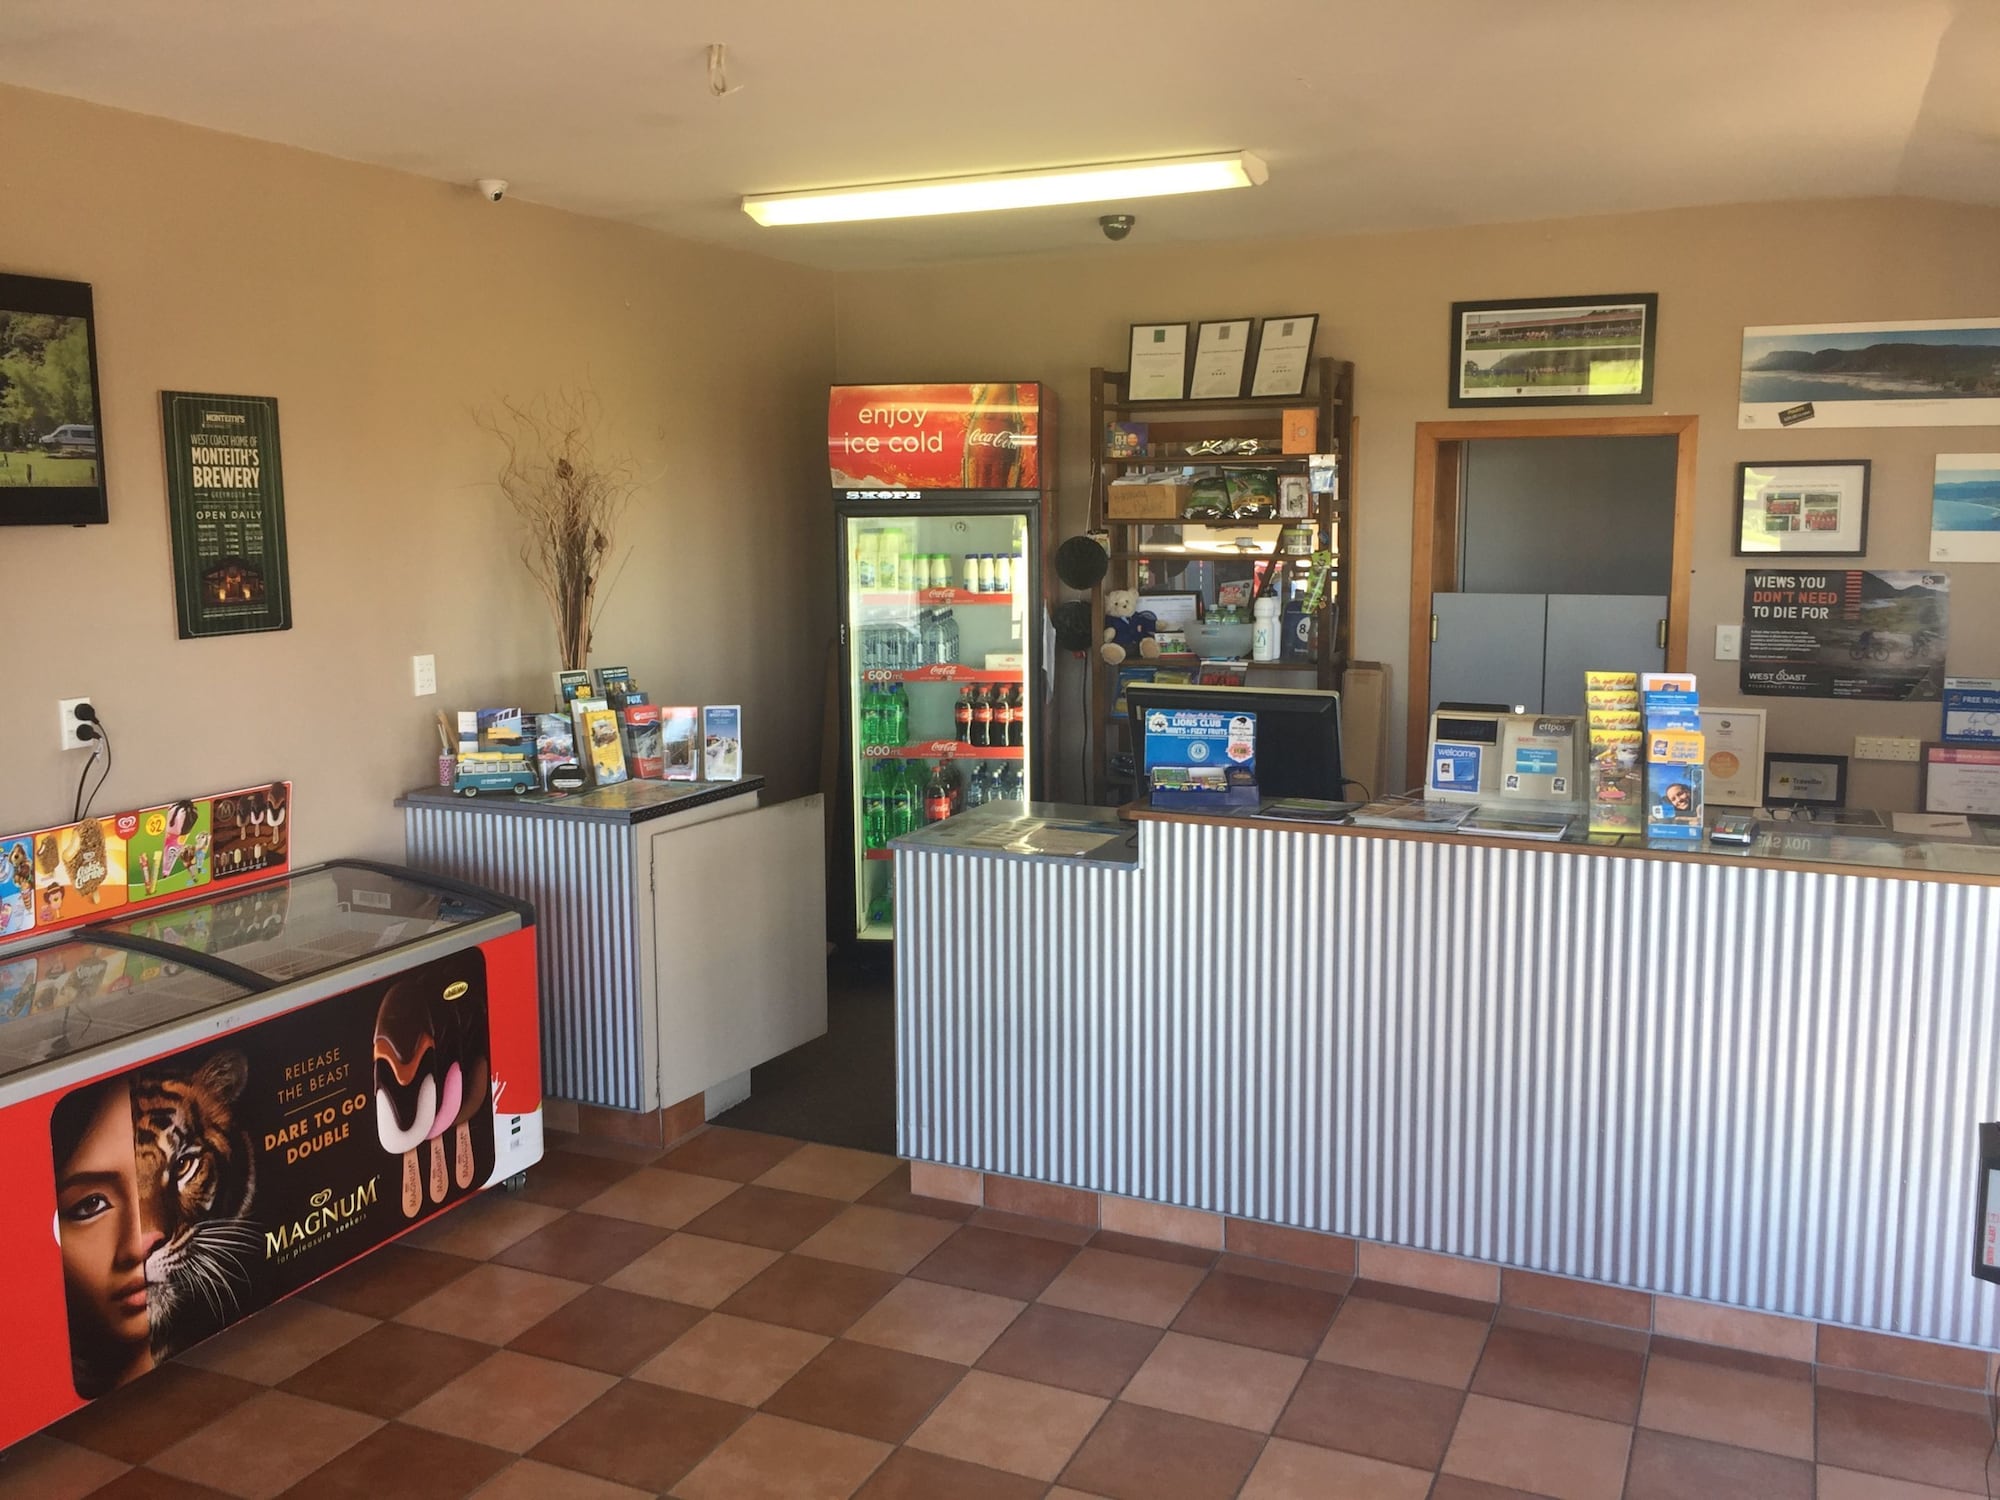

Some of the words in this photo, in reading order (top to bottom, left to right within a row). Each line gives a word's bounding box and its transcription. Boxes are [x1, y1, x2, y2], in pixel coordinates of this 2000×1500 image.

[858, 407, 928, 428] enjoy
[191, 434, 208, 445] WEST
[210, 434, 230, 446] COAST
[231, 435, 248, 447] HOME
[249, 436, 258, 447] OF
[844, 432, 880, 455] ice
[888, 431, 943, 453] cold
[968, 428, 1019, 450] Coca-Cola
[191, 447, 260, 466] MONTEITH'S
[192, 466, 260, 489] BREWERY
[846, 490, 922, 500] SKOPE
[196, 511, 227, 520] OPEN
[231, 510, 263, 519] DAILY
[1753, 576, 1796, 588] VIEWS
[1799, 576, 1826, 589] YOU
[1753, 591, 1795, 603] DON'T
[1798, 592, 1838, 604] NEED
[1752, 606, 1769, 618] TO
[1773, 607, 1798, 619] DIE
[1801, 607, 1829, 619] FOR
[868, 670, 892, 680] 600
[1776, 673, 1807, 681] COAST
[1962, 695, 1981, 704] FREE
[1172, 718, 1198, 727] LIONS
[1199, 718, 1222, 728] CLUB
[1539, 723, 1566, 733] eftpos
[866, 745, 890, 756] 600
[1437, 748, 1477, 758] welcome
[149, 819, 162, 833] $2
[285, 1048, 341, 1081] RELEASE
[278, 1083, 303, 1104] THE
[309, 1063, 350, 1092] BEAST
[264, 1119, 309, 1151] DARE
[314, 1107, 336, 1128] TO
[341, 1093, 366, 1116] GO
[286, 1122, 350, 1165] DOUBLE
[264, 1176, 379, 1260] MAGNUM
[293, 1232, 332, 1258] pleasure
